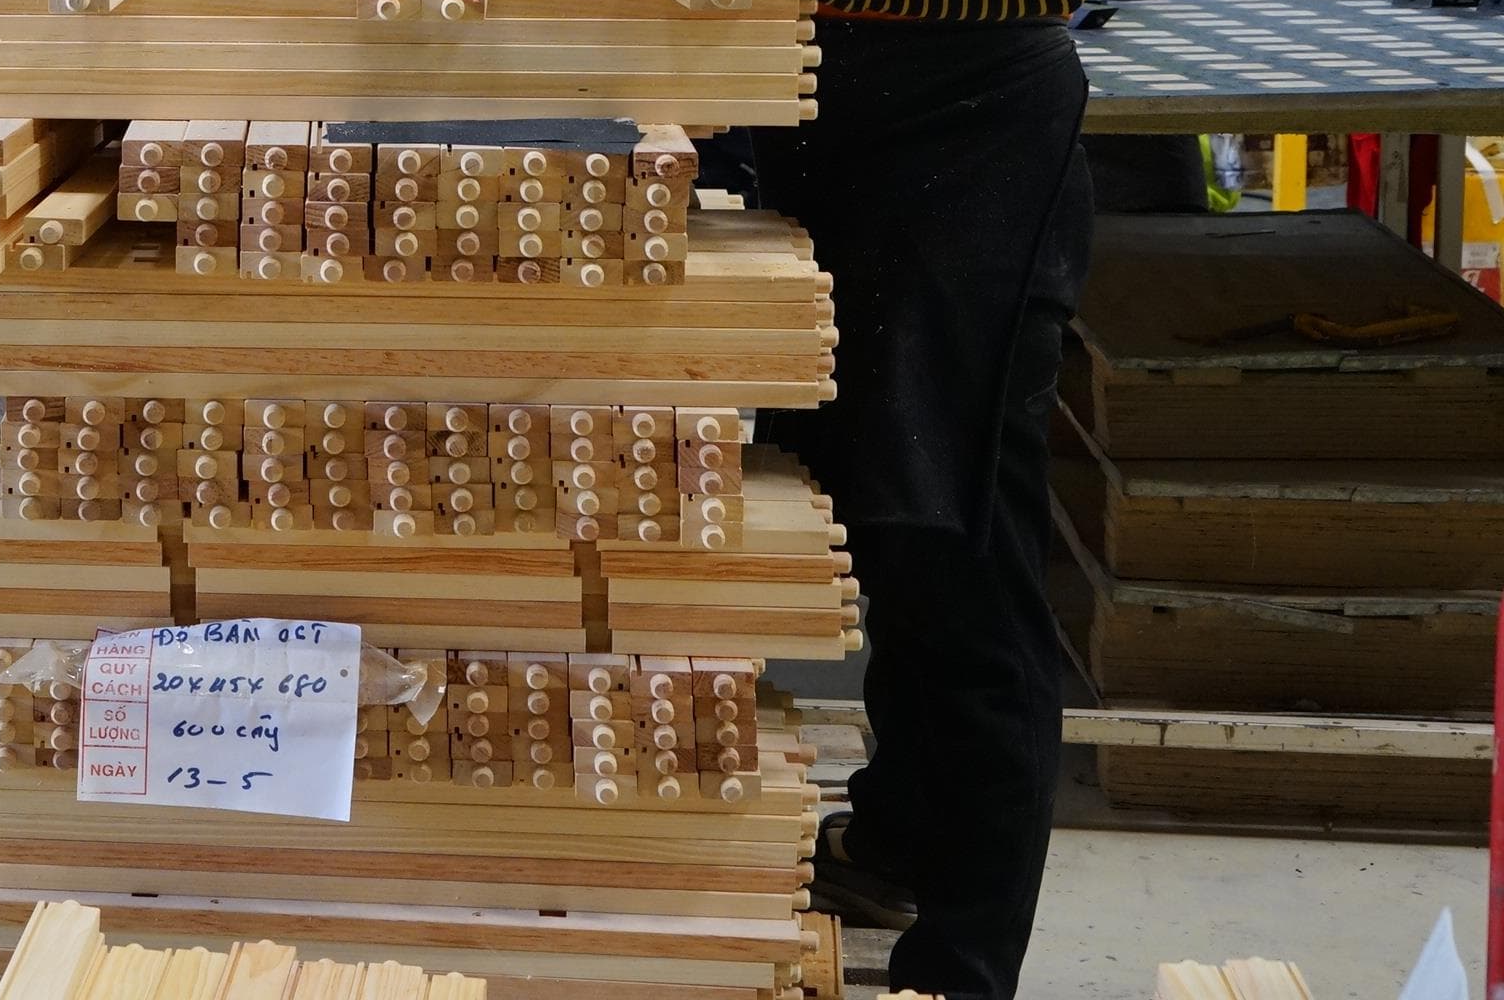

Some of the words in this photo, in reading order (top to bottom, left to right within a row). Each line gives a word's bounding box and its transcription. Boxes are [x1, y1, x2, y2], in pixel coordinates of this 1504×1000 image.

[96, 642, 146, 655] HÀNG
[99, 662, 138, 675] QUY
[91, 680, 142, 696] CÁCH
[104, 705, 127, 722] SỐ
[89, 725, 141, 743] LƯỢNG
[90, 761, 137, 778] NGÀY
